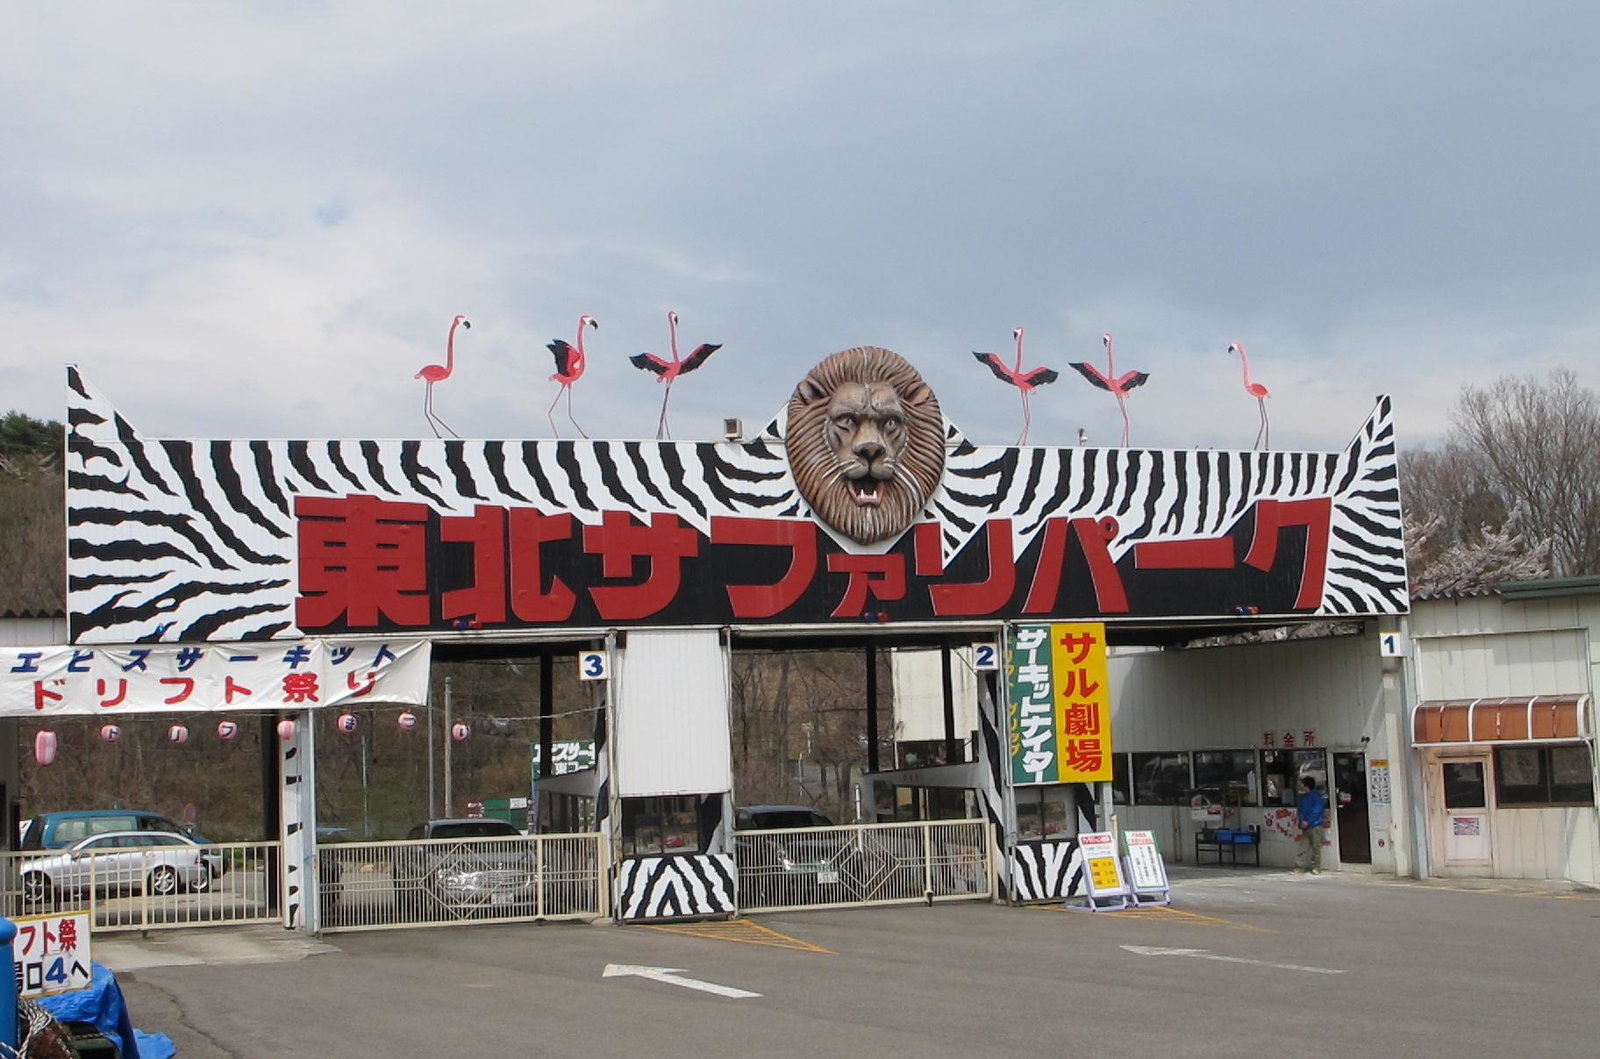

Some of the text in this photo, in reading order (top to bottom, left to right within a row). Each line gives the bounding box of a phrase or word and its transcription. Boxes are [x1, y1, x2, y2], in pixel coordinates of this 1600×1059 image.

[294, 494, 1331, 627] 東北サファリパーク
[976, 646, 993, 665] 2
[1384, 635, 1394, 653] 1
[585, 654, 604, 677] 3
[34, 671, 376, 710] ドリフト祭り
[1016, 628, 1053, 783] サーキットナイター
[1060, 632, 1103, 773] サル劇場
[12, 919, 77, 956] フト祭
